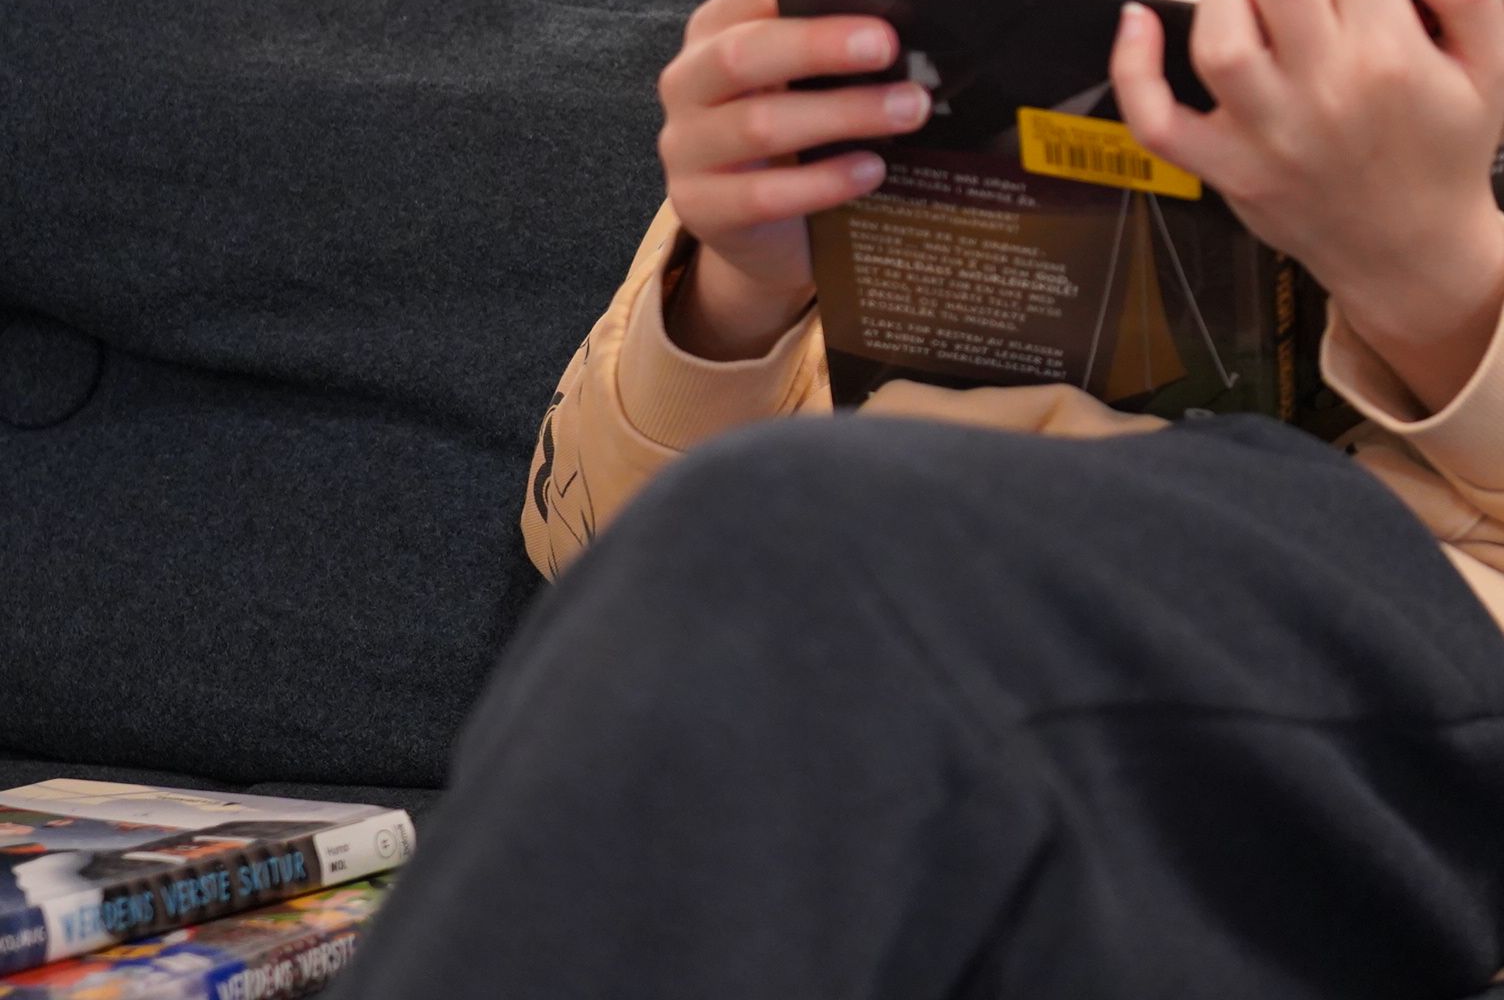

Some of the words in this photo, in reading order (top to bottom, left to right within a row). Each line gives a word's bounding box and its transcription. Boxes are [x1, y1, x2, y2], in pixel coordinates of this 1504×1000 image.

[849, 219, 879, 231] MEN
[852, 252, 953, 277] GAMMELDAGS
[861, 316, 903, 331] FLAKS
[935, 328, 984, 345] RESTEN
[987, 336, 1005, 347] AV
[1008, 340, 1065, 358] KLASSEN
[60, 889, 154, 943] VERDENS
[159, 870, 231, 918] VERSTE
[237, 850, 307, 898] SKITUR
